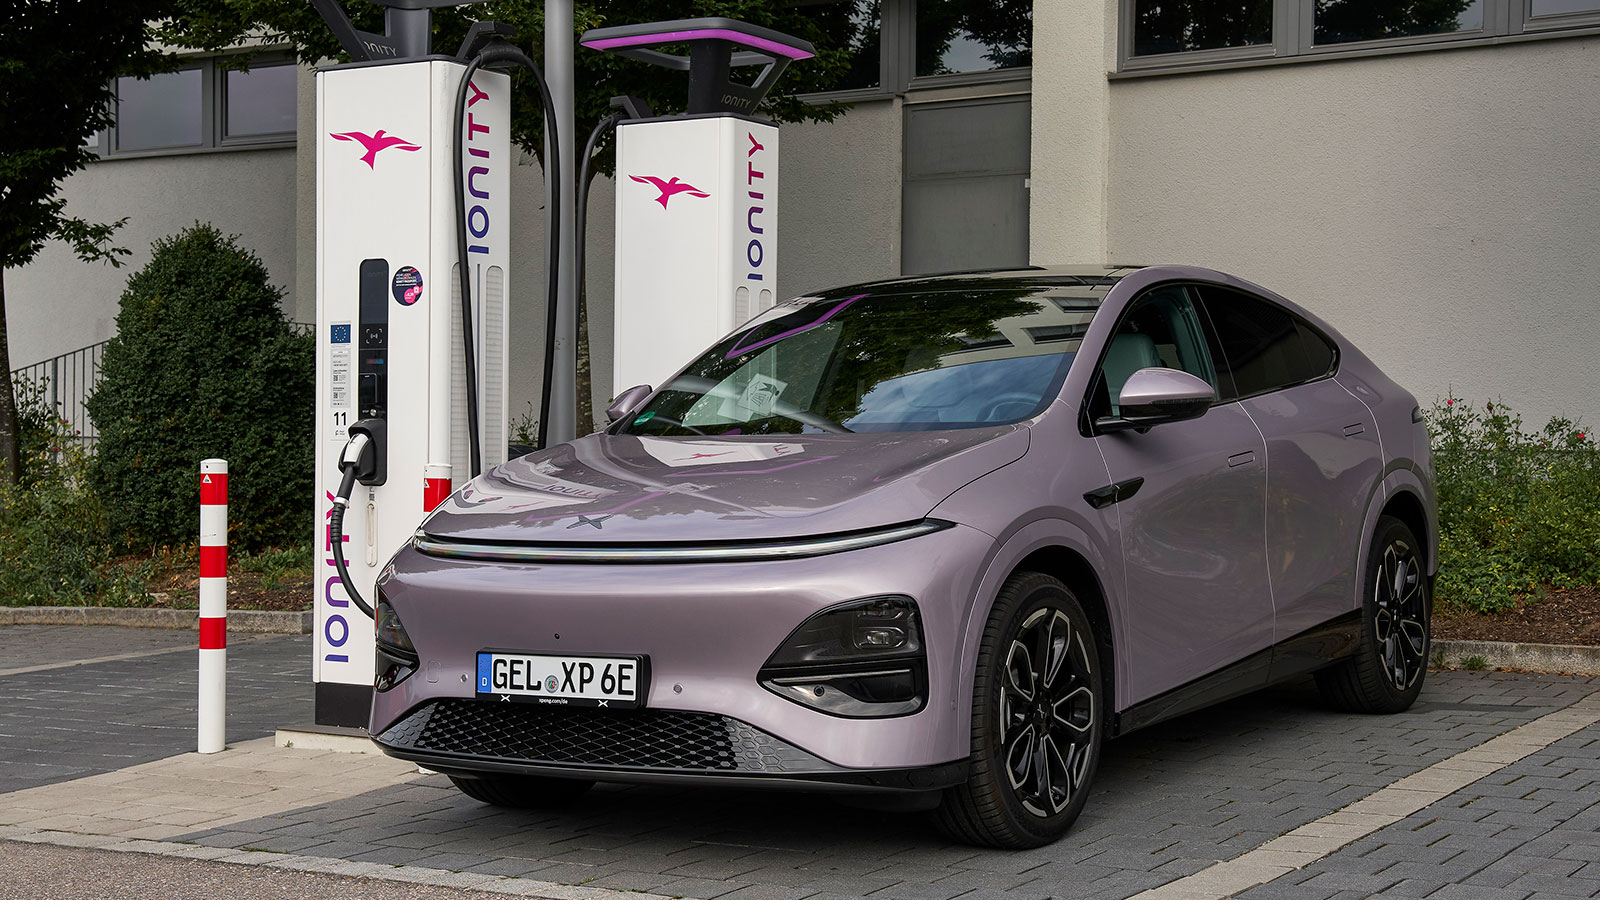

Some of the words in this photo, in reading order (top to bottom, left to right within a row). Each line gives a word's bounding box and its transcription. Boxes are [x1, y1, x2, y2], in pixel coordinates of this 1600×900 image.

[721, 94, 752, 109] IONITY
[468, 81, 490, 254] IONITY
[747, 132, 765, 281] IONITY
[333, 412, 347, 426] 11
[481, 677, 488, 687] D
[492, 658, 542, 691] GEL
[560, 661, 595, 693] XP
[600, 663, 634, 696] 6E
[538, 697, 568, 705] xpeng.com/de
